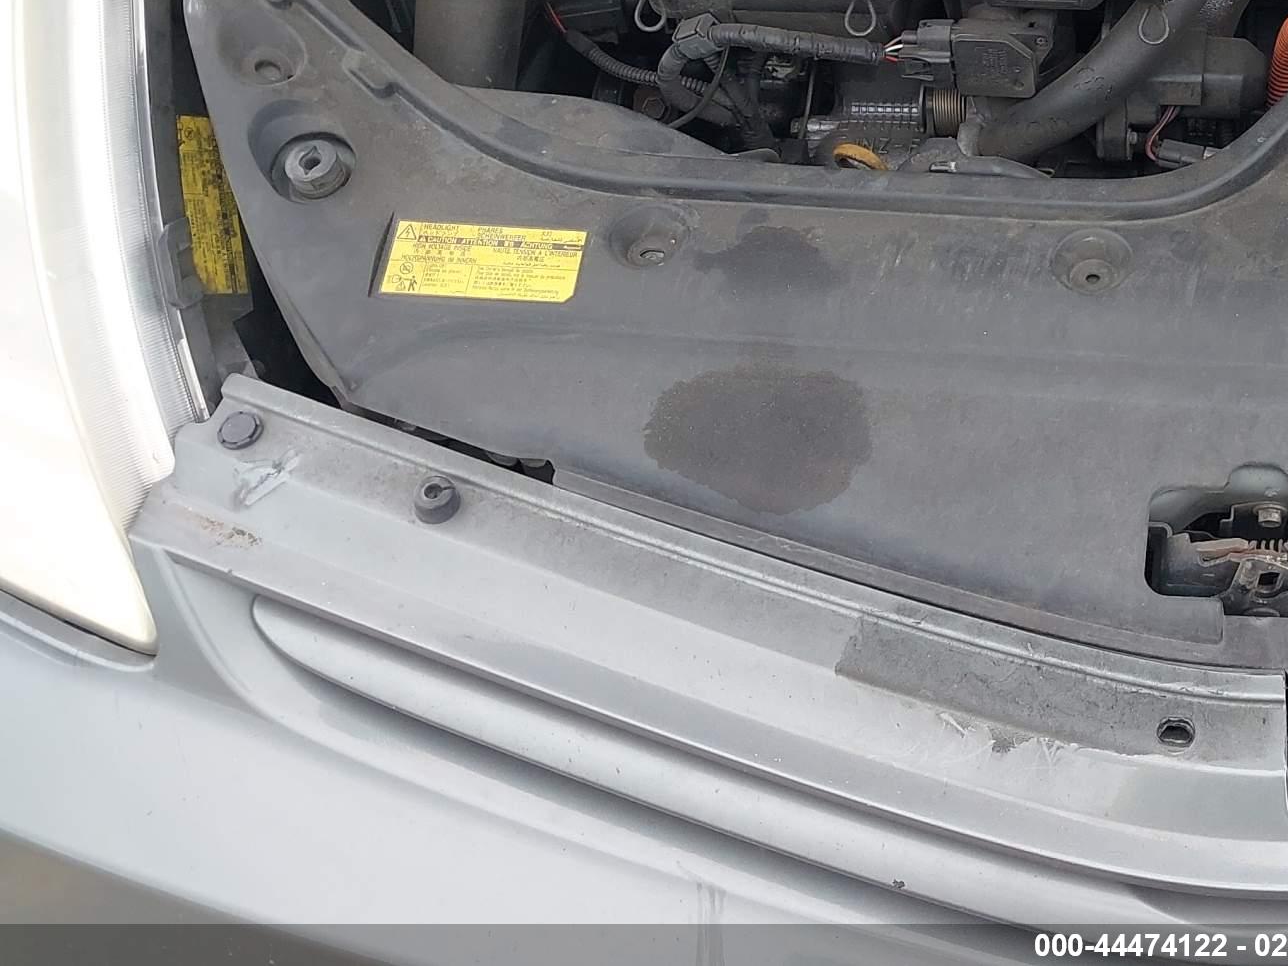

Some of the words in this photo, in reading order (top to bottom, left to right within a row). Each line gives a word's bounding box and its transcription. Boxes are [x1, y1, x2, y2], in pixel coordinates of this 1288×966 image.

[423, 223, 460, 232] HEADLIGHT
[428, 236, 457, 244] CAUTION
[462, 238, 500, 247] ATTENTION
[520, 240, 553, 250] ACHTUNG
